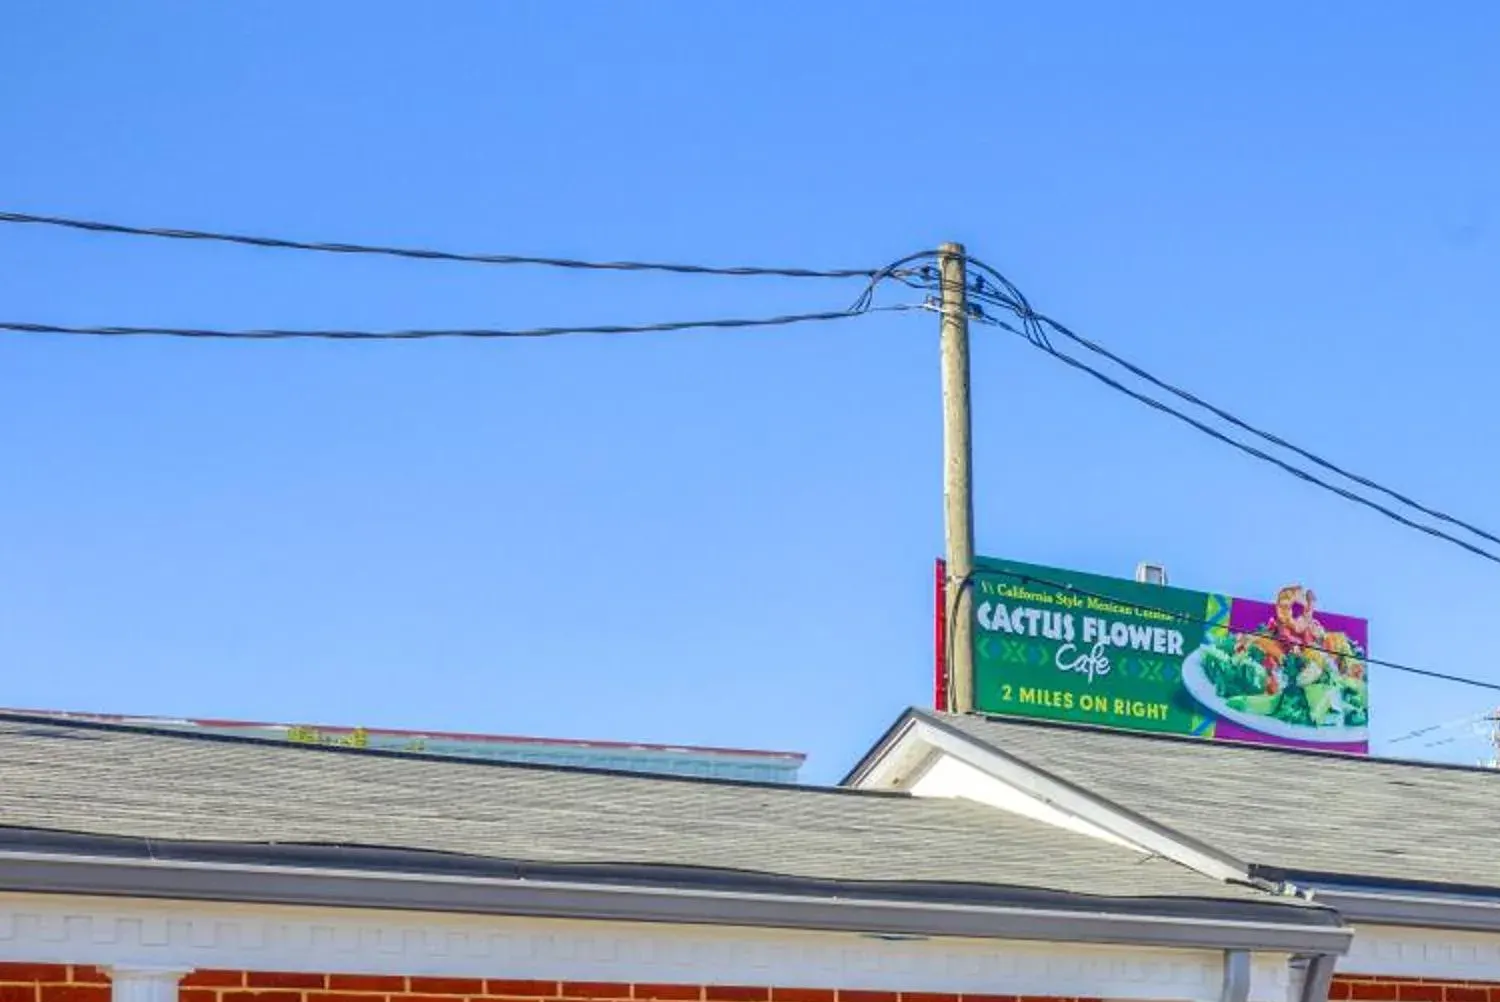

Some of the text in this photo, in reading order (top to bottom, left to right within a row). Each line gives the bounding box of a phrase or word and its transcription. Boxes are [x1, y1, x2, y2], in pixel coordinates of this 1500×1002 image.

[997, 583, 1053, 604] California
[1056, 591, 1082, 608] Style
[977, 600, 1185, 656] CACTUS FLOWER
[1001, 685, 1169, 720] 2 MILES ON RIGHT
